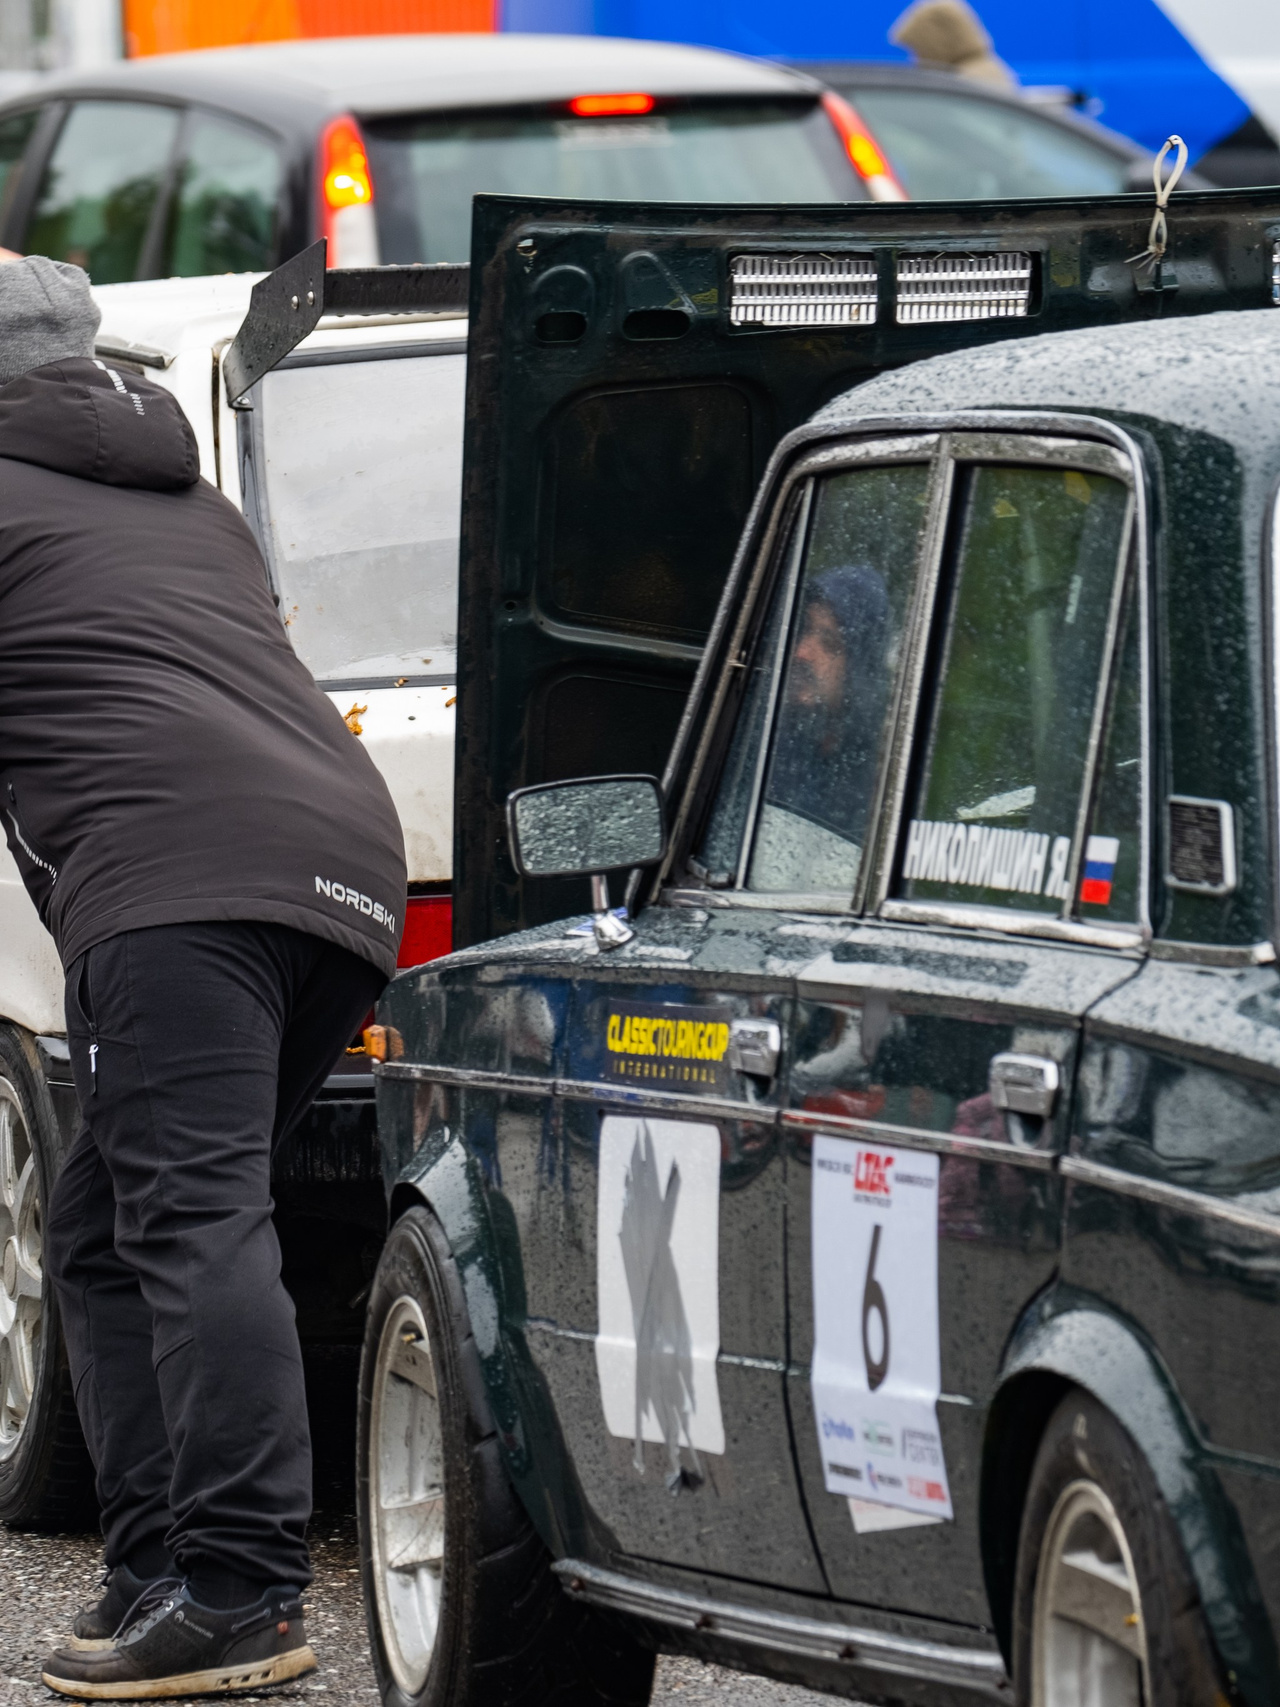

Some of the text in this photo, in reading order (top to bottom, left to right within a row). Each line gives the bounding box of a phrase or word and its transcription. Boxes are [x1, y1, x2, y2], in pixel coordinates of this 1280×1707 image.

[902, 819, 1049, 895] НИКОЛИШИН
[314, 875, 396, 934] NORDSKI
[613, 1059, 716, 1084] INTERNATIONAL
[861, 1224, 891, 1392] 6
